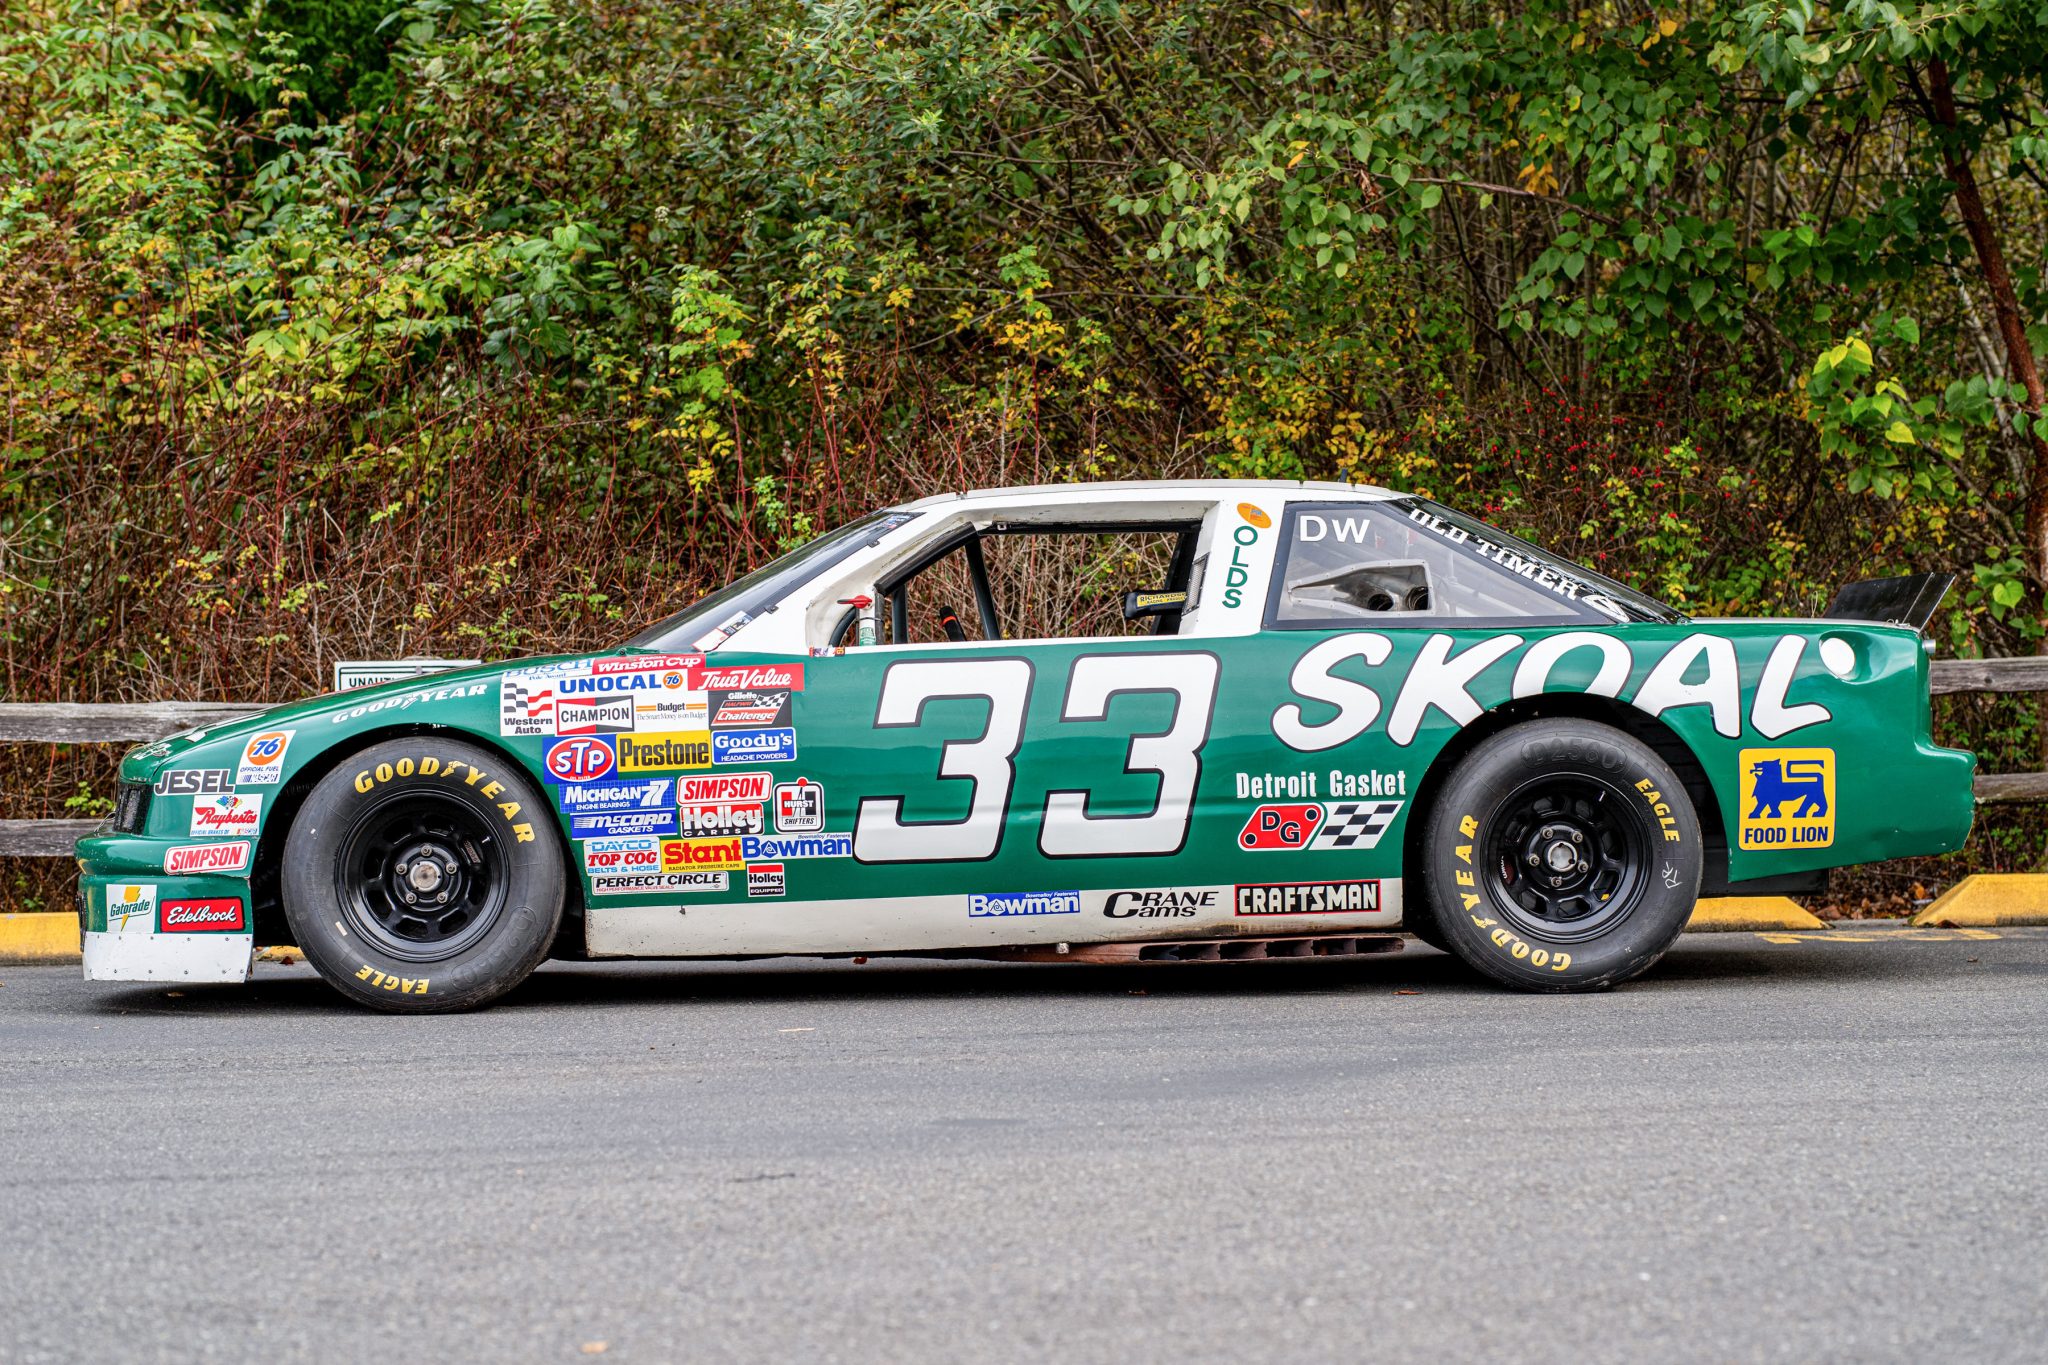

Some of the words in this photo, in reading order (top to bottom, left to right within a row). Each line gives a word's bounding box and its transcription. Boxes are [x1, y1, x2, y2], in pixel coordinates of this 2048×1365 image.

[1300, 515, 1371, 544] DW
[1408, 508, 1468, 545] OLD
[1475, 538, 1584, 601] TIMER
[1222, 525, 1258, 609] OLDS
[598, 657, 664, 673] Winston
[666, 656, 702, 668] Cup
[349, 677, 394, 688] UNA
[559, 674, 662, 694] UNOCAL
[666, 675, 680, 685] 76
[1271, 632, 1832, 752] SKOAL
[332, 684, 488, 724] GOODYEAR
[728, 691, 757, 700] Gillette
[561, 707, 630, 723] CHAMPION
[657, 703, 686, 713] Budget
[717, 709, 776, 721] Challenge
[504, 717, 553, 726] Western
[514, 726, 543, 734] Auto
[252, 737, 281, 757] 76
[620, 738, 709, 767] Prestone
[714, 732, 793, 754] Goody's
[555, 741, 606, 775] STP
[721, 754, 755, 762] HEADACHE
[756, 752, 788, 760] POWDERS
[853, 649, 1223, 865] 33
[155, 770, 235, 795] JESEL
[564, 785, 641, 804] MICHIGAN
[640, 780, 670, 806] 77
[684, 777, 765, 800] SIMPSON
[1236, 771, 1317, 799] Detroit
[1329, 769, 1406, 797] Gasket
[354, 756, 536, 844] GOODYEAR
[576, 803, 599, 811] ENGINE
[599, 801, 631, 809] BEARINGS
[784, 800, 814, 809] HURST
[1634, 778, 1681, 842] EAGLE
[195, 807, 258, 829] Raybestos
[683, 805, 764, 833] Holley
[784, 817, 815, 826] SHIFTERS
[1260, 810, 1301, 844] DG
[608, 825, 654, 835] GASKETS
[684, 828, 741, 837] CARBS
[1744, 827, 1787, 845] FOOD
[1792, 826, 1829, 844] LION
[591, 840, 652, 852] DAYCO
[665, 840, 742, 865] Stant
[742, 836, 851, 858] Bowman
[170, 845, 241, 871] SIMPSON
[588, 853, 620, 867] TOP
[624, 852, 657, 866] COG
[588, 866, 618, 874] BELTS
[620, 865, 628, 873] &
[631, 864, 660, 872] HOSE
[596, 875, 668, 888] PERFECT
[668, 873, 722, 885] CIRCLE
[749, 873, 784, 885] Holley
[1238, 884, 1378, 914] CRAFTSMAN
[1455, 814, 1572, 972] GOODYEAR
[110, 899, 151, 917] Gatorade
[167, 904, 238, 924] Edelbrock
[969, 894, 1080, 916] Bowman
[1103, 891, 1219, 918] CRANE
[355, 963, 430, 995] EAGLE
